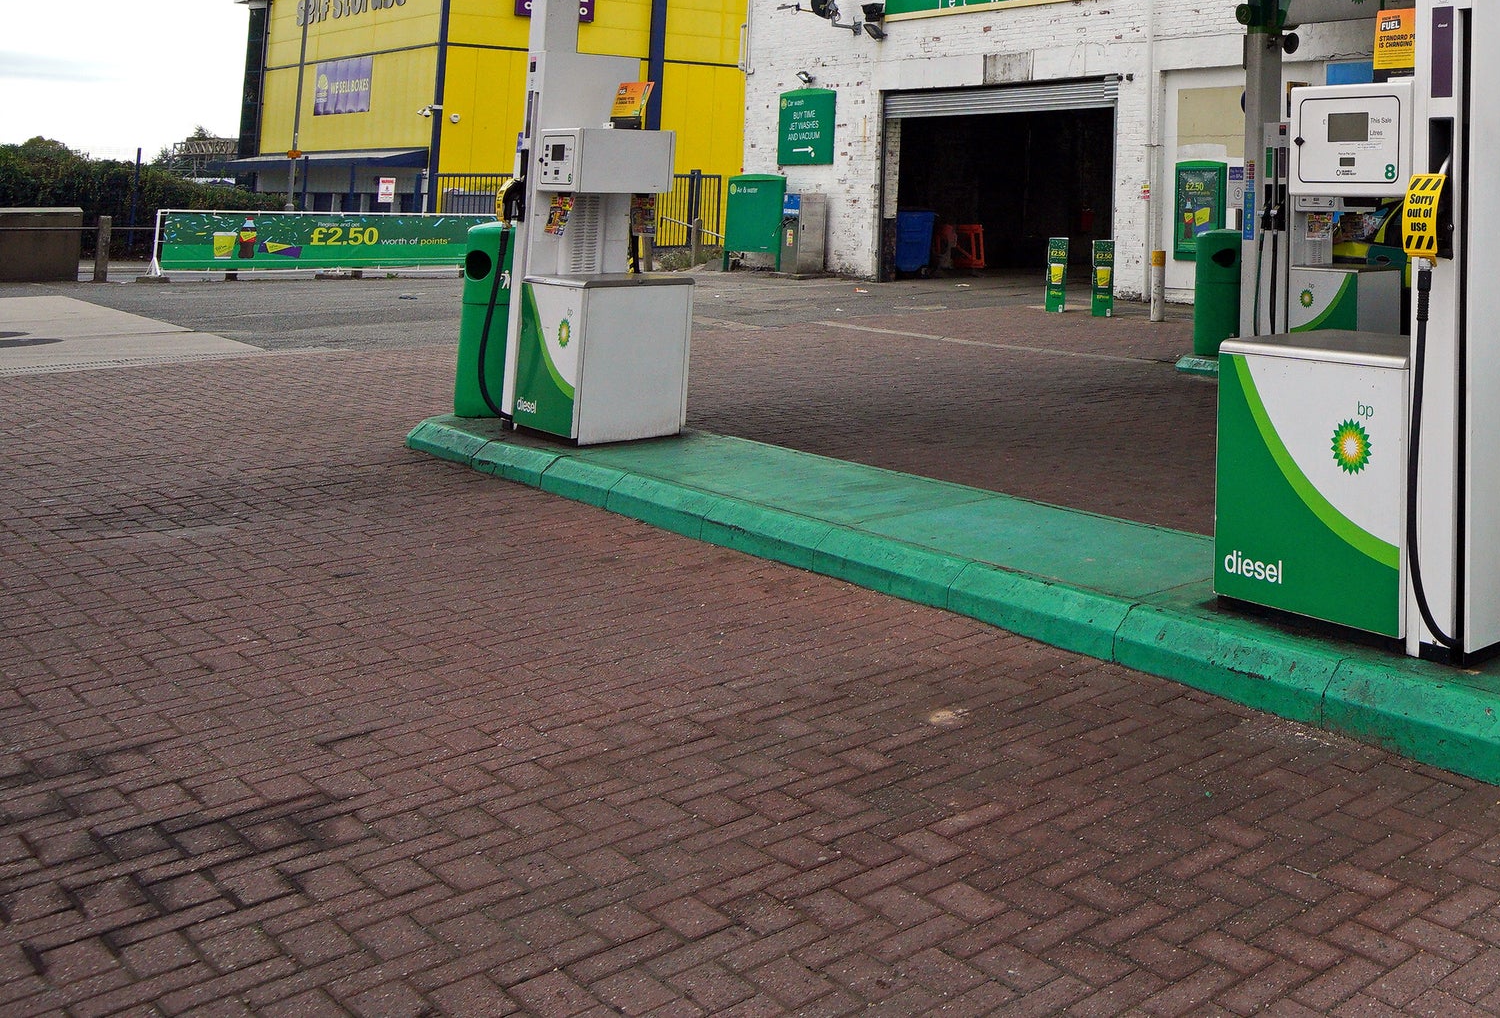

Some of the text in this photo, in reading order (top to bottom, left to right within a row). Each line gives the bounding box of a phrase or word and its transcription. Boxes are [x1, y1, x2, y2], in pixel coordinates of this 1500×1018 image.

[1382, 22, 1400, 31] FUEL
[1379, 34, 1408, 42] STANDARD
[1386, 40, 1412, 48] CHANGING
[340, 80, 350, 94] SELL
[352, 78, 370, 92] BOXES
[792, 110, 816, 120] BUY TIME
[789, 120, 819, 131] JET WASHES
[787, 132, 820, 141] AND VACUUM
[1384, 164, 1396, 180] 8
[743, 186, 746, 194] &
[1410, 194, 1434, 206] Sorry
[1406, 207, 1432, 218] out of
[1410, 222, 1427, 232] use
[310, 226, 379, 246] £2.50
[381, 237, 408, 245] worth
[409, 237, 418, 245] of
[567, 307, 574, 318] bp
[516, 396, 536, 414] diesel
[1358, 400, 1374, 420] bp
[1224, 550, 1283, 584] diesel
